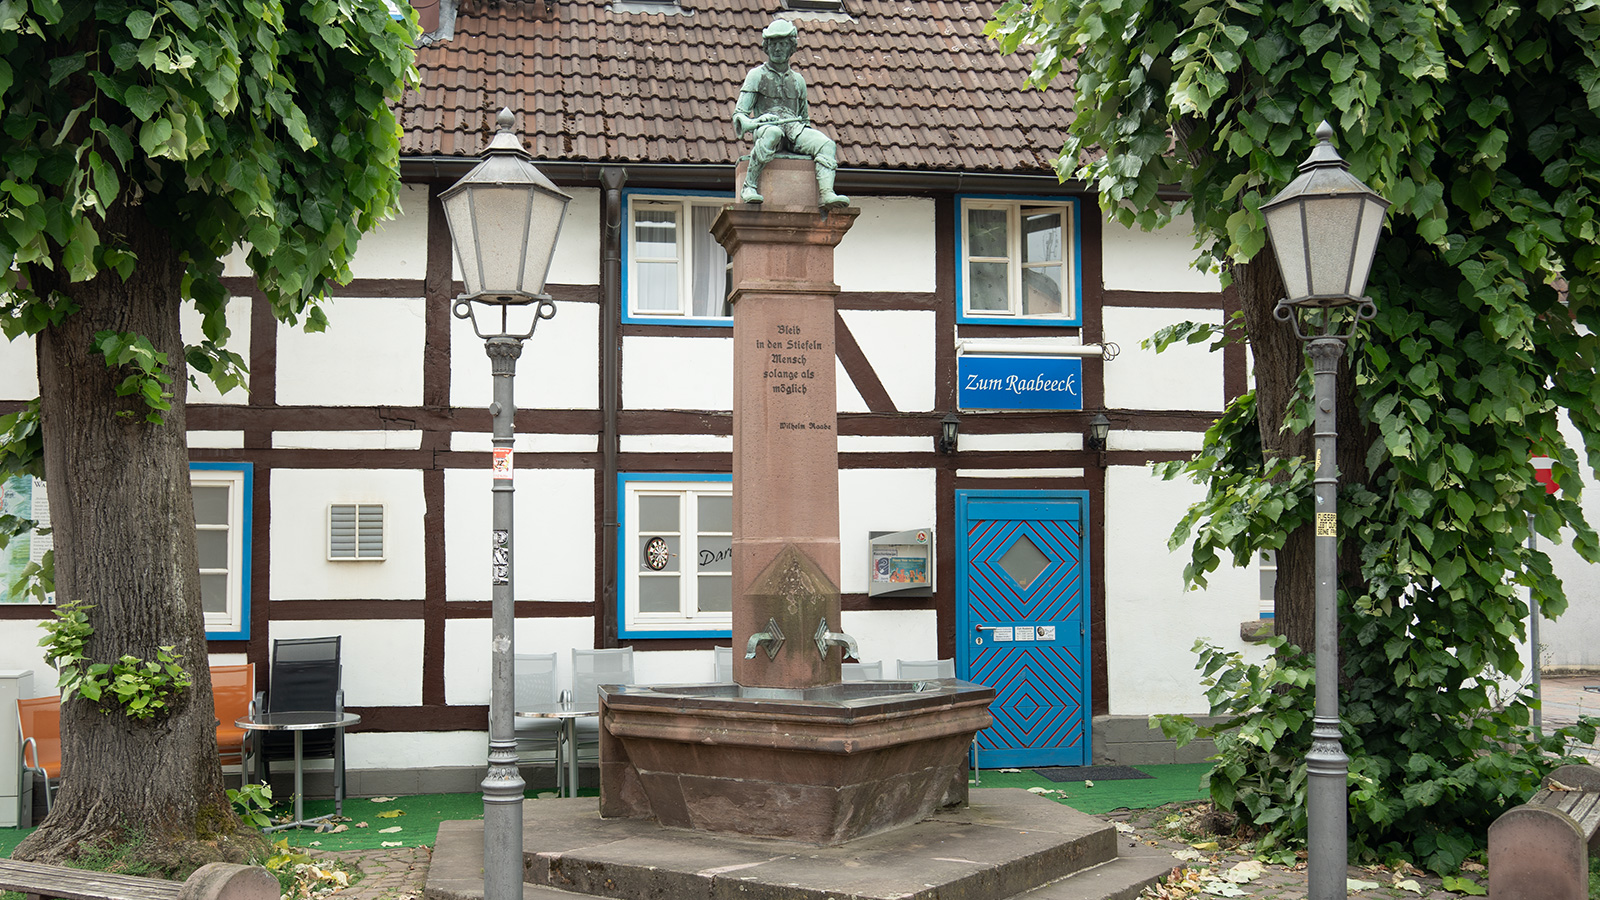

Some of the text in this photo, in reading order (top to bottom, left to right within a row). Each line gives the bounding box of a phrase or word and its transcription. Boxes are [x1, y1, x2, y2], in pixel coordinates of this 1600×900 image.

[777, 325, 800, 335] Bleib
[756, 340, 822, 351] in den Stiefeln
[771, 354, 807, 366] Mensch
[763, 369, 815, 380] solange als
[772, 384, 807, 395] möglich
[965, 373, 1077, 396] Zum Raabeeck
[780, 422, 831, 431] Wilhelm Raabe
